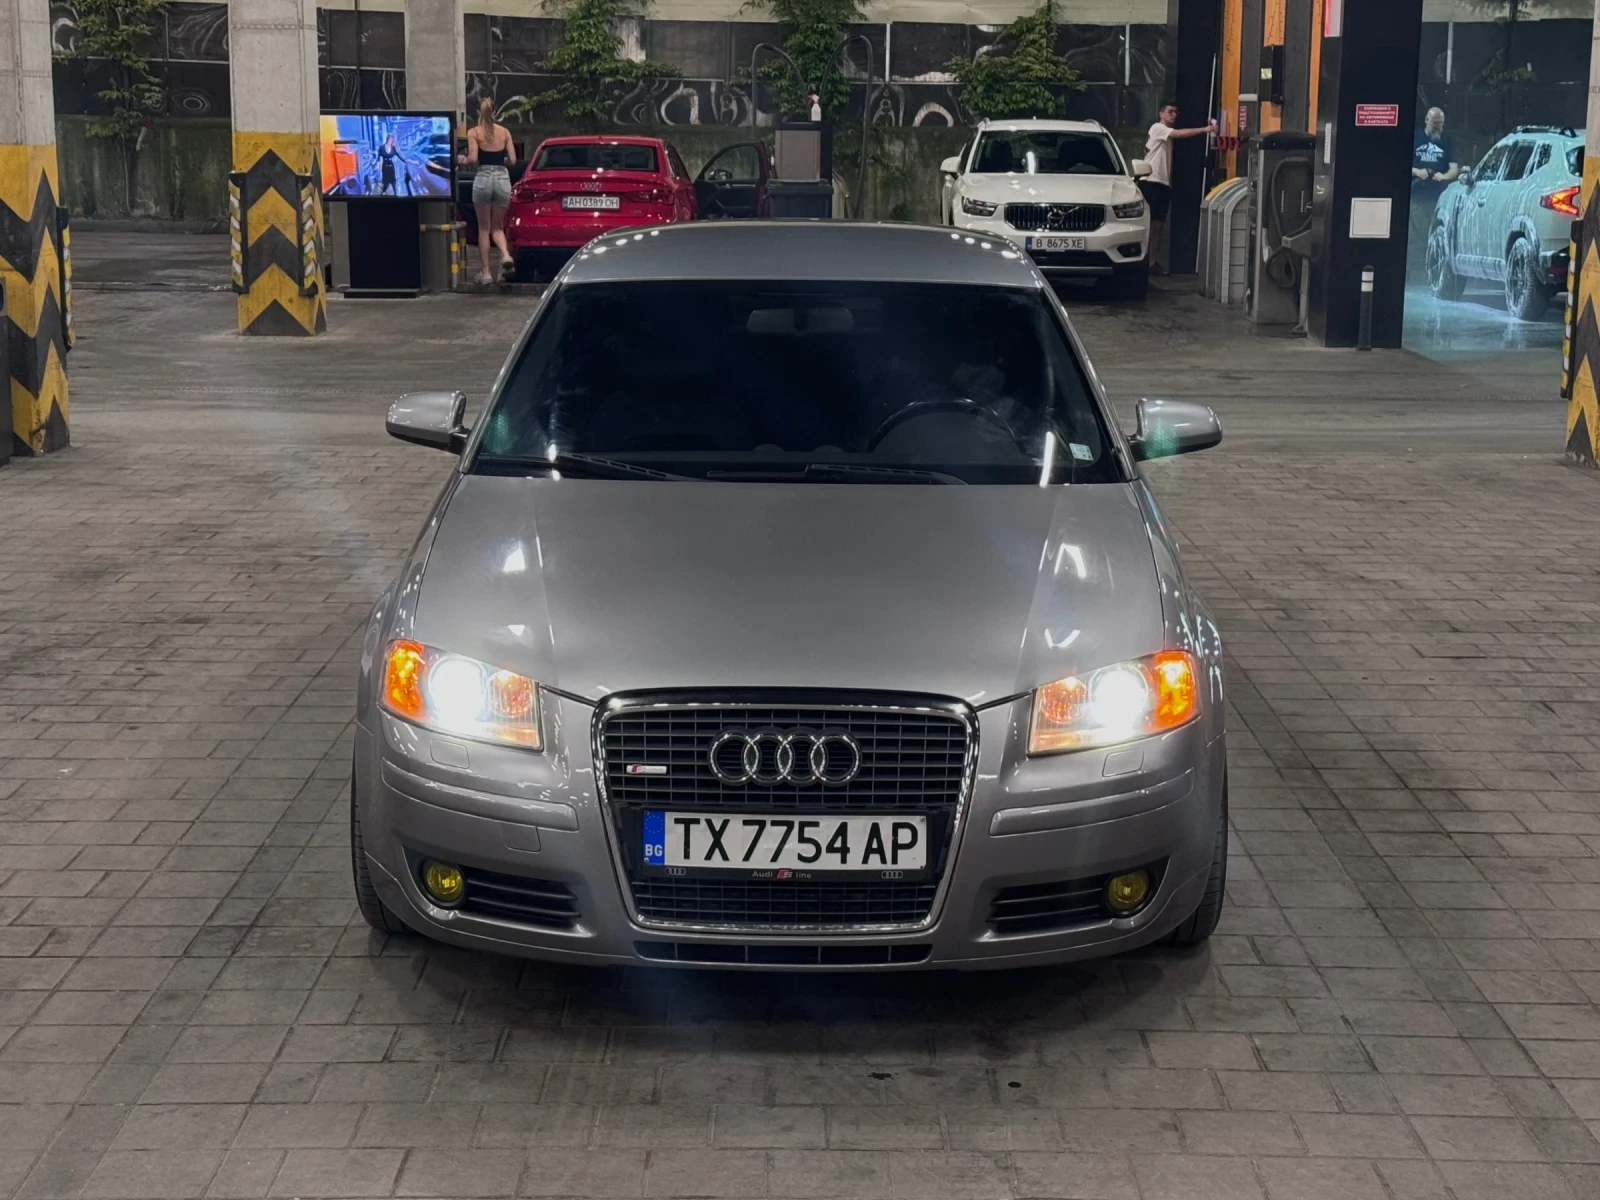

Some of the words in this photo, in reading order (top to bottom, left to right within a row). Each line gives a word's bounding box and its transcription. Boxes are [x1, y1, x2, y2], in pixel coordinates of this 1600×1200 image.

[1036, 238, 1042, 248] B
[1047, 238, 1069, 248] 8675
[1071, 238, 1083, 248] XE
[673, 817, 731, 861] TX
[741, 819, 851, 865] 7754
[861, 821, 919, 865] AP
[644, 843, 663, 857] BG
[752, 870, 773, 878] Audi
